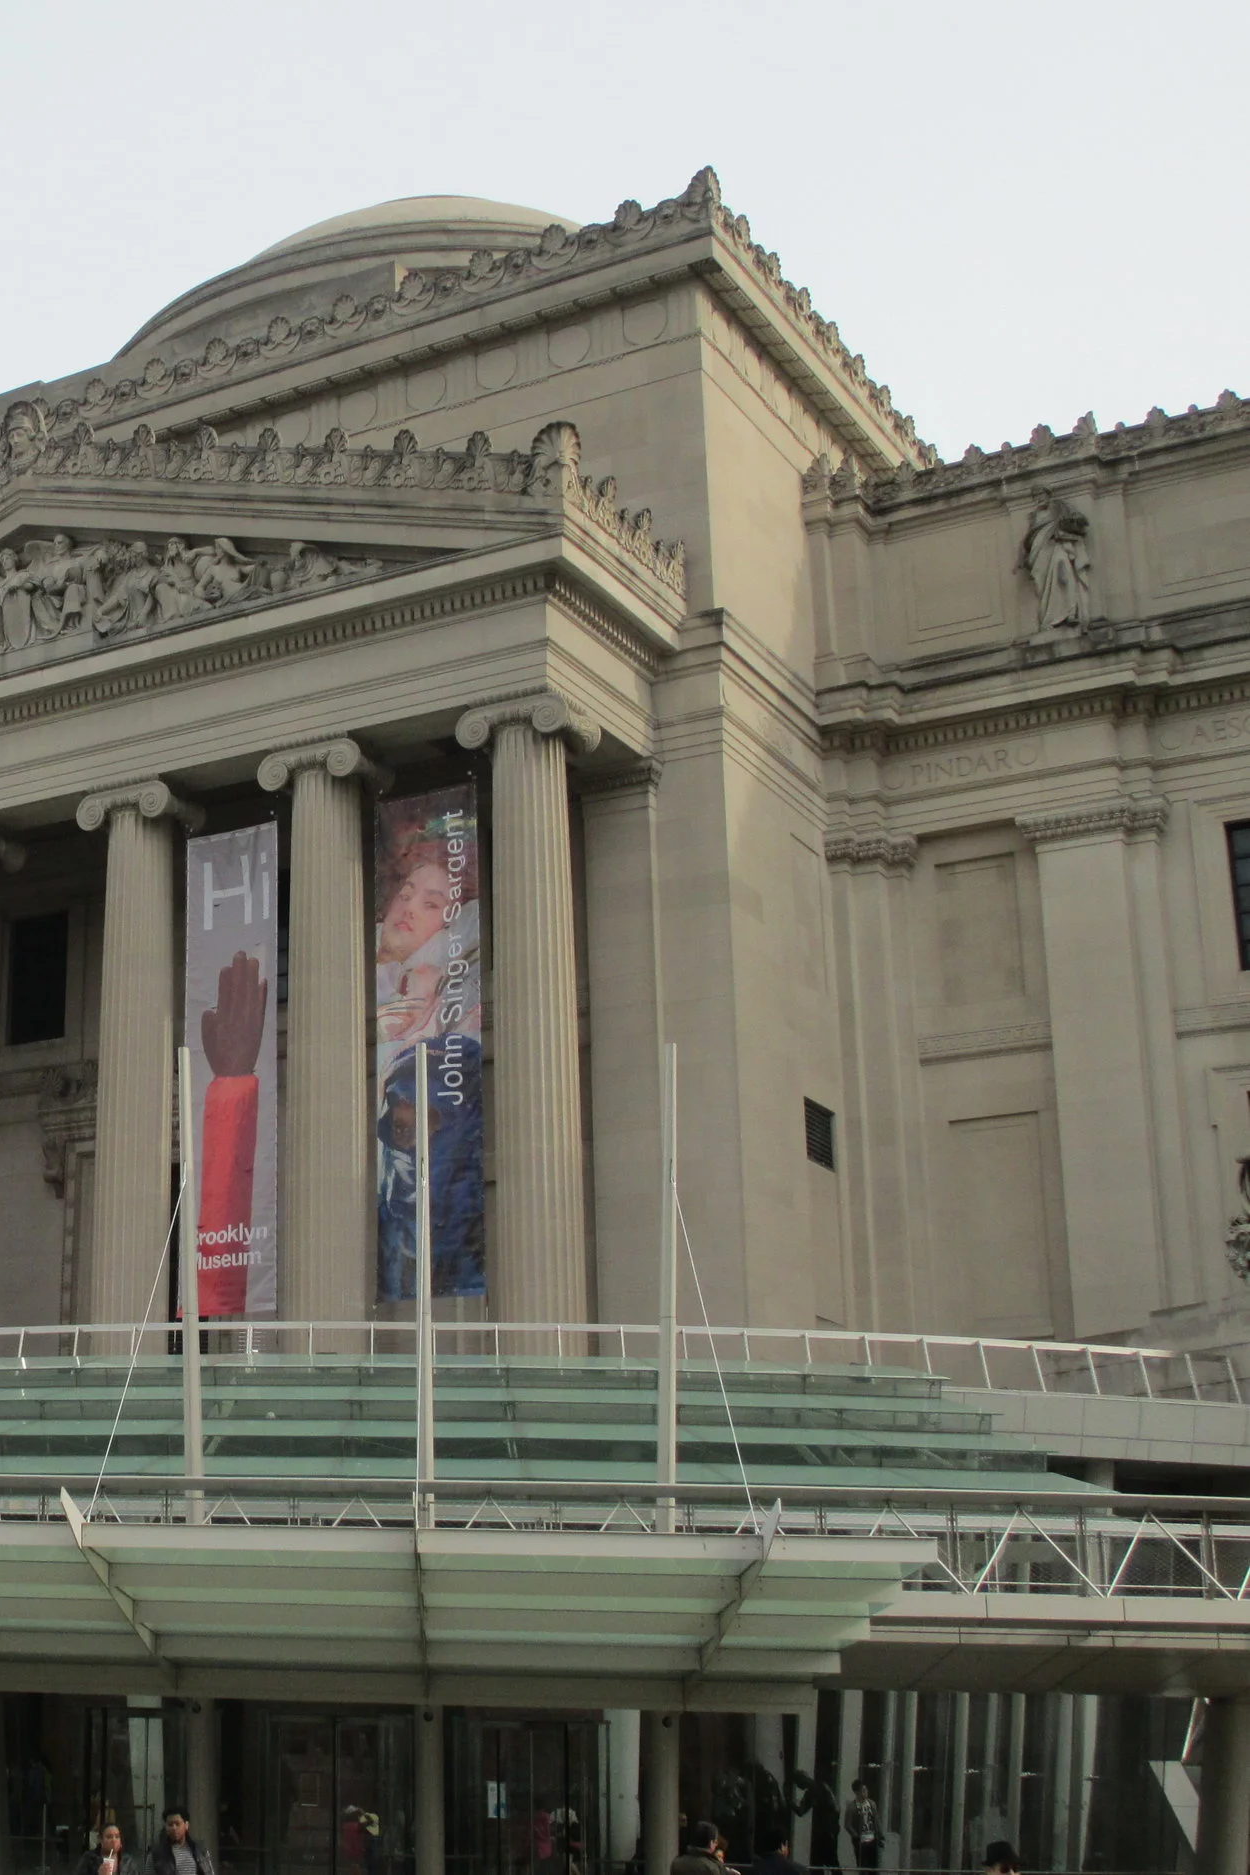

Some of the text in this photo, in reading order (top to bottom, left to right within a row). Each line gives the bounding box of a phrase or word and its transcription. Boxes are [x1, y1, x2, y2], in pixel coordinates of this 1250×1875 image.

[910, 748, 1013, 787] PINDAR
[203, 851, 270, 931] Hi
[437, 808, 469, 1107] John Singer Sargent
[196, 1222, 268, 1246] rooklyn
